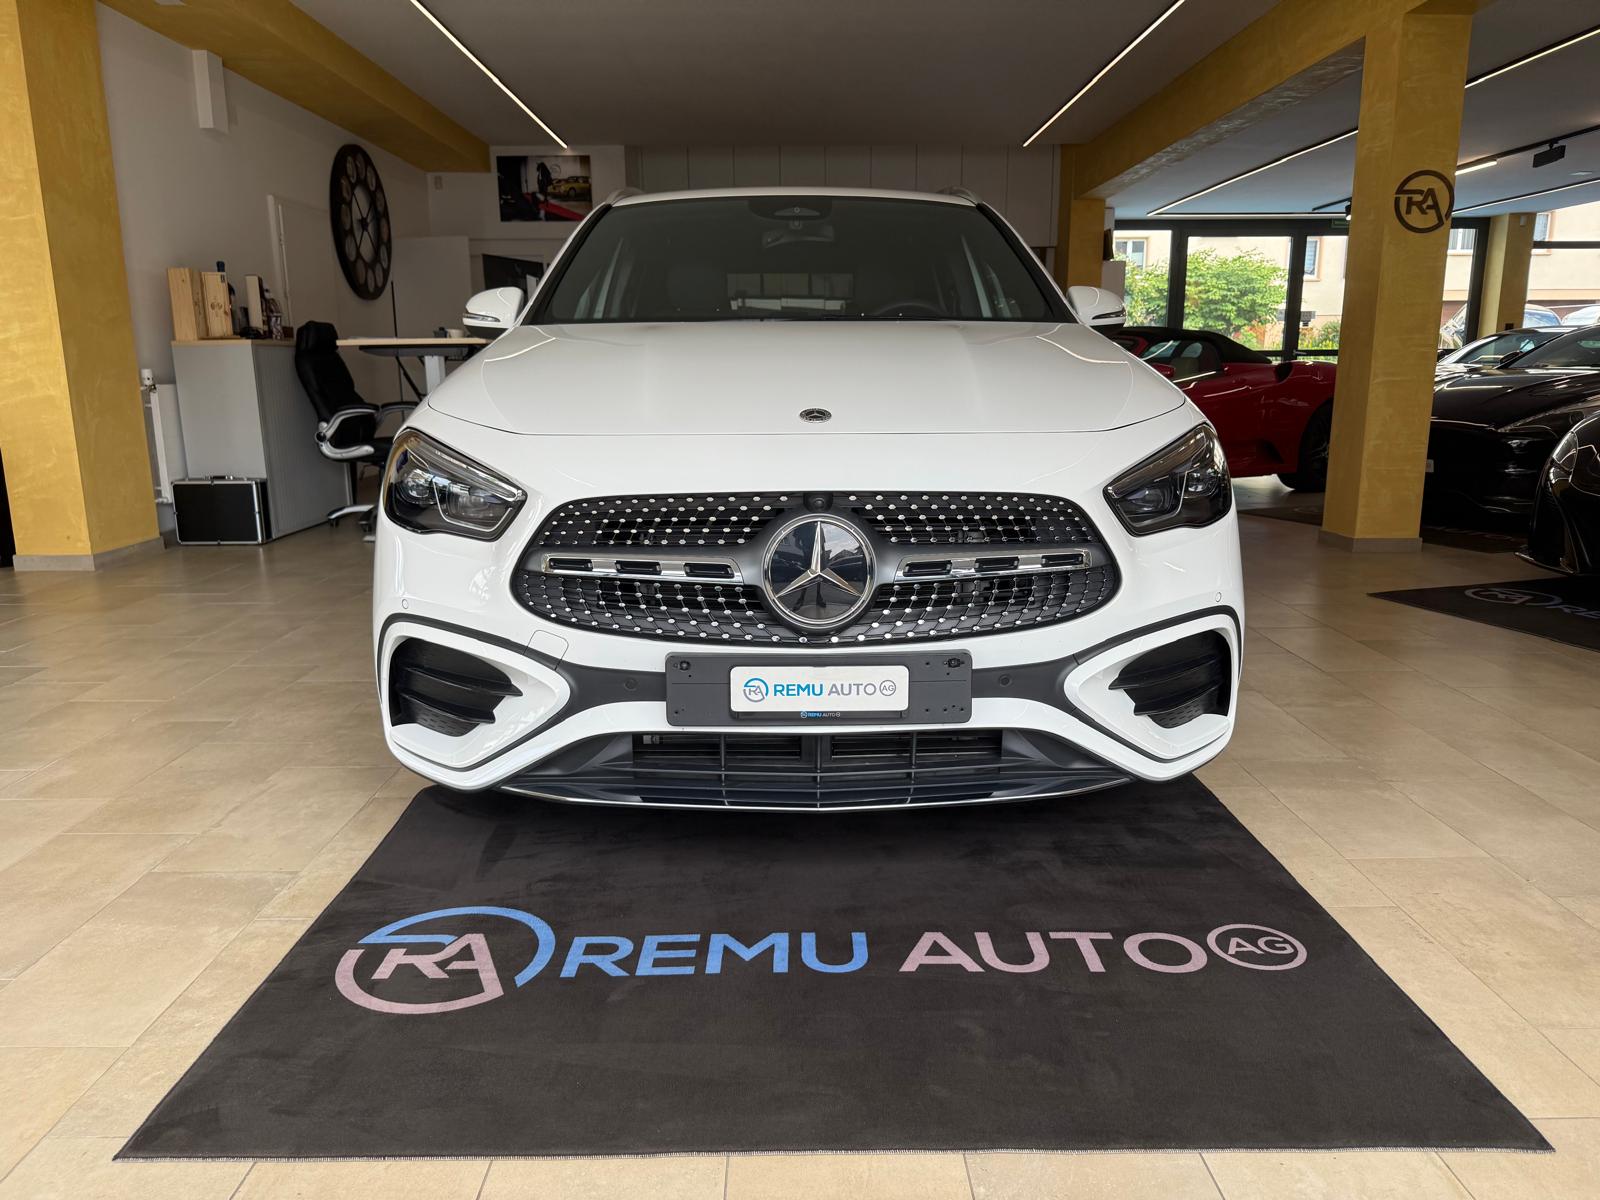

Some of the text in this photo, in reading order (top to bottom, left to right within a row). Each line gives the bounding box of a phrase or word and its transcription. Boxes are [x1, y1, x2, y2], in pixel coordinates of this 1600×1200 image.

[773, 682, 823, 697] REMU
[827, 682, 877, 696] AUTO
[881, 683, 895, 693] AG
[560, 931, 869, 978] REMU
[899, 931, 1208, 973] AUTO
[1226, 936, 1295, 955] AG
